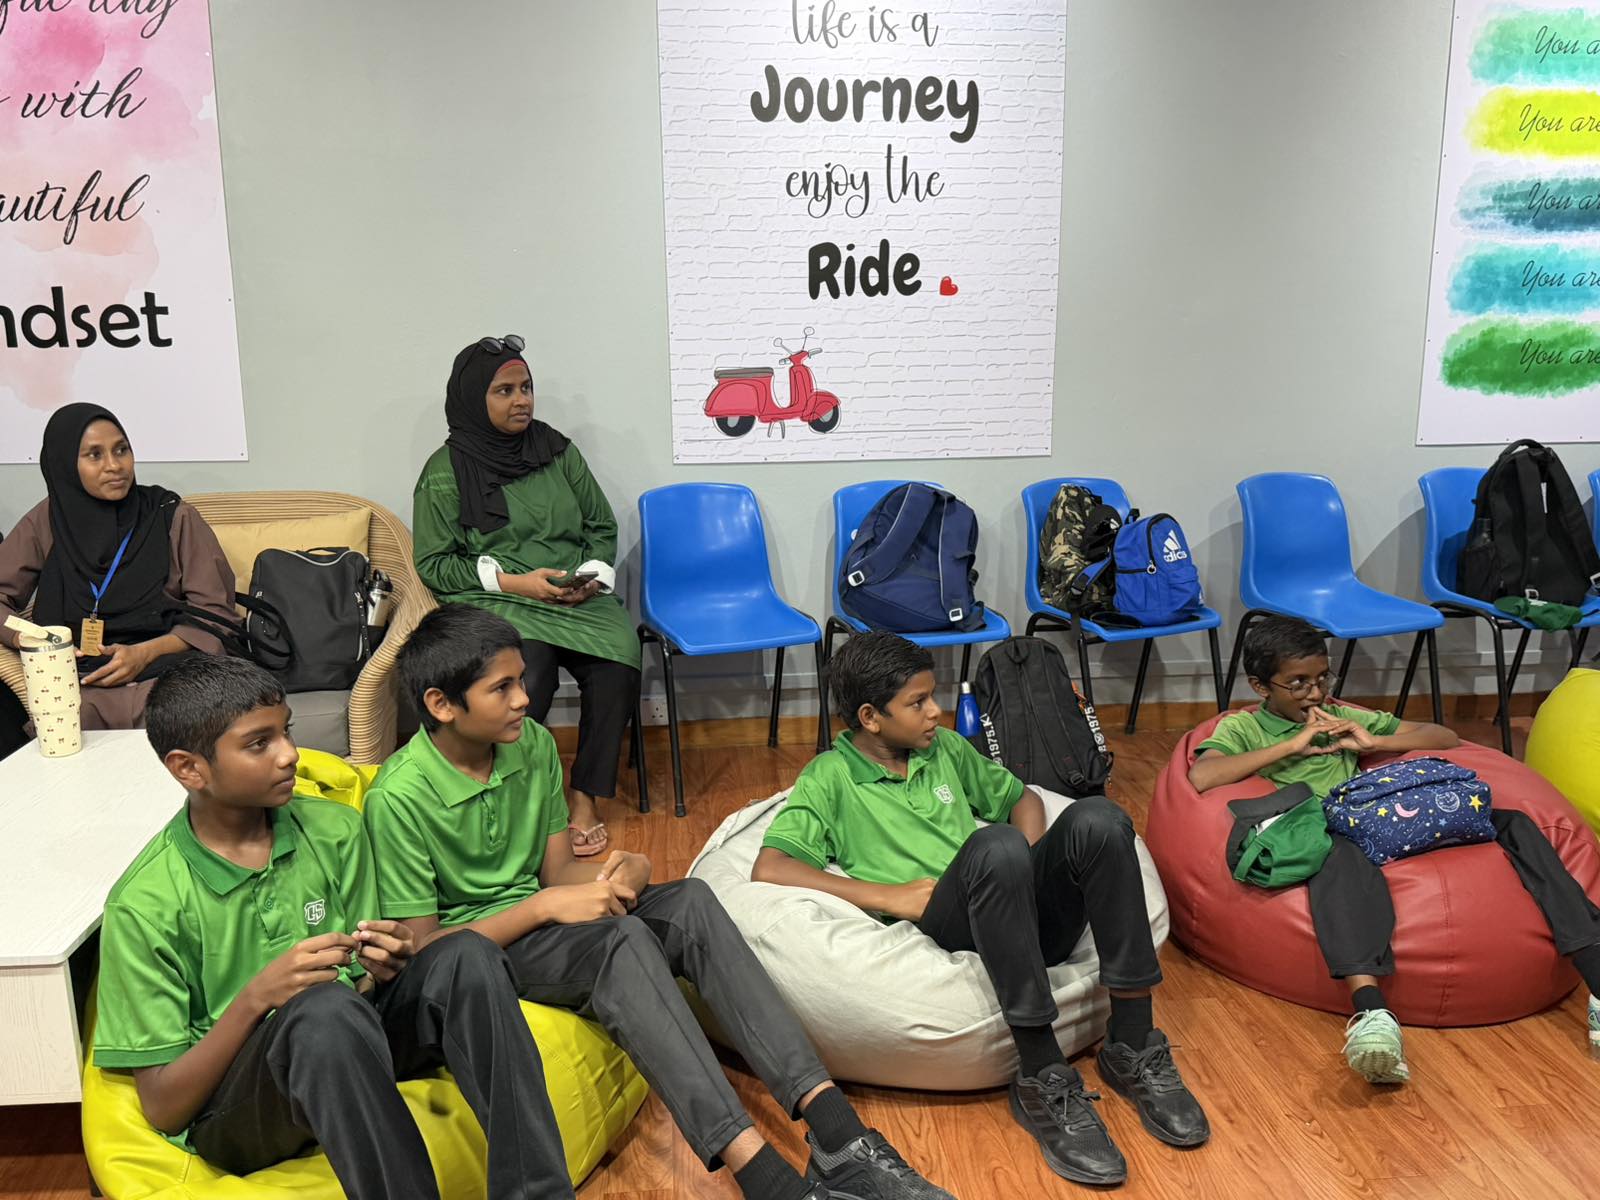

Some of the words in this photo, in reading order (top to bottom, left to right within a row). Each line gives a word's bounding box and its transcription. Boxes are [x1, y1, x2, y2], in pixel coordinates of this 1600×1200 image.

[792, 0, 857, 48] life
[868, 5, 900, 42] is
[911, 12, 939, 47] a
[1535, 25, 1580, 64] You
[21, 67, 147, 118] with
[750, 64, 980, 143] Journey
[1519, 103, 1564, 141] You
[785, 162, 870, 218] enjoy
[884, 144, 945, 203] the
[1528, 182, 1573, 219] You
[808, 238, 922, 300] Ride
[1521, 260, 1566, 296] You
[1519, 338, 1565, 373] You
